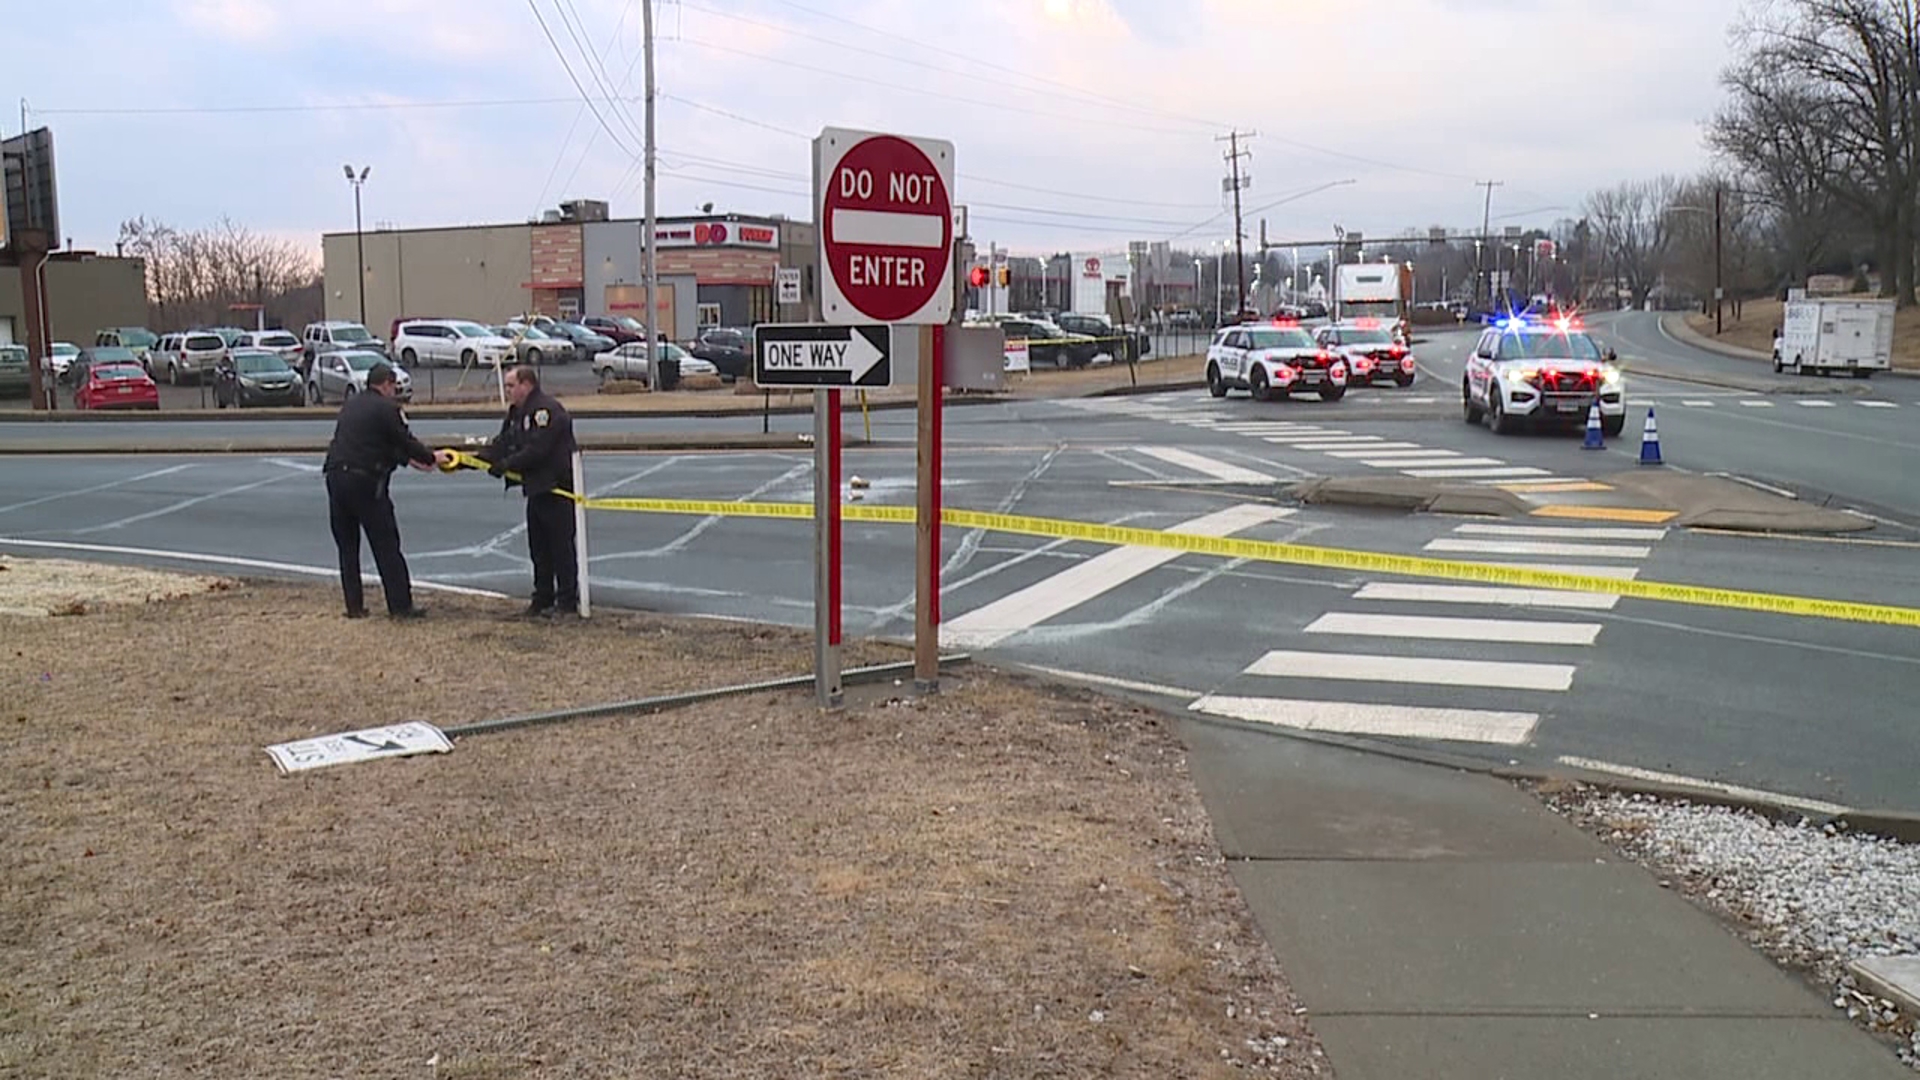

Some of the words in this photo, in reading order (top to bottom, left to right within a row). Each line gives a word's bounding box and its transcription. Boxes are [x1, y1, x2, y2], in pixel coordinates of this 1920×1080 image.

[841, 167, 873, 199] DO
[889, 171, 935, 205] NOT
[850, 255, 925, 287] ENTER
[768, 344, 803, 367] ONE
[809, 344, 848, 367] WAY
